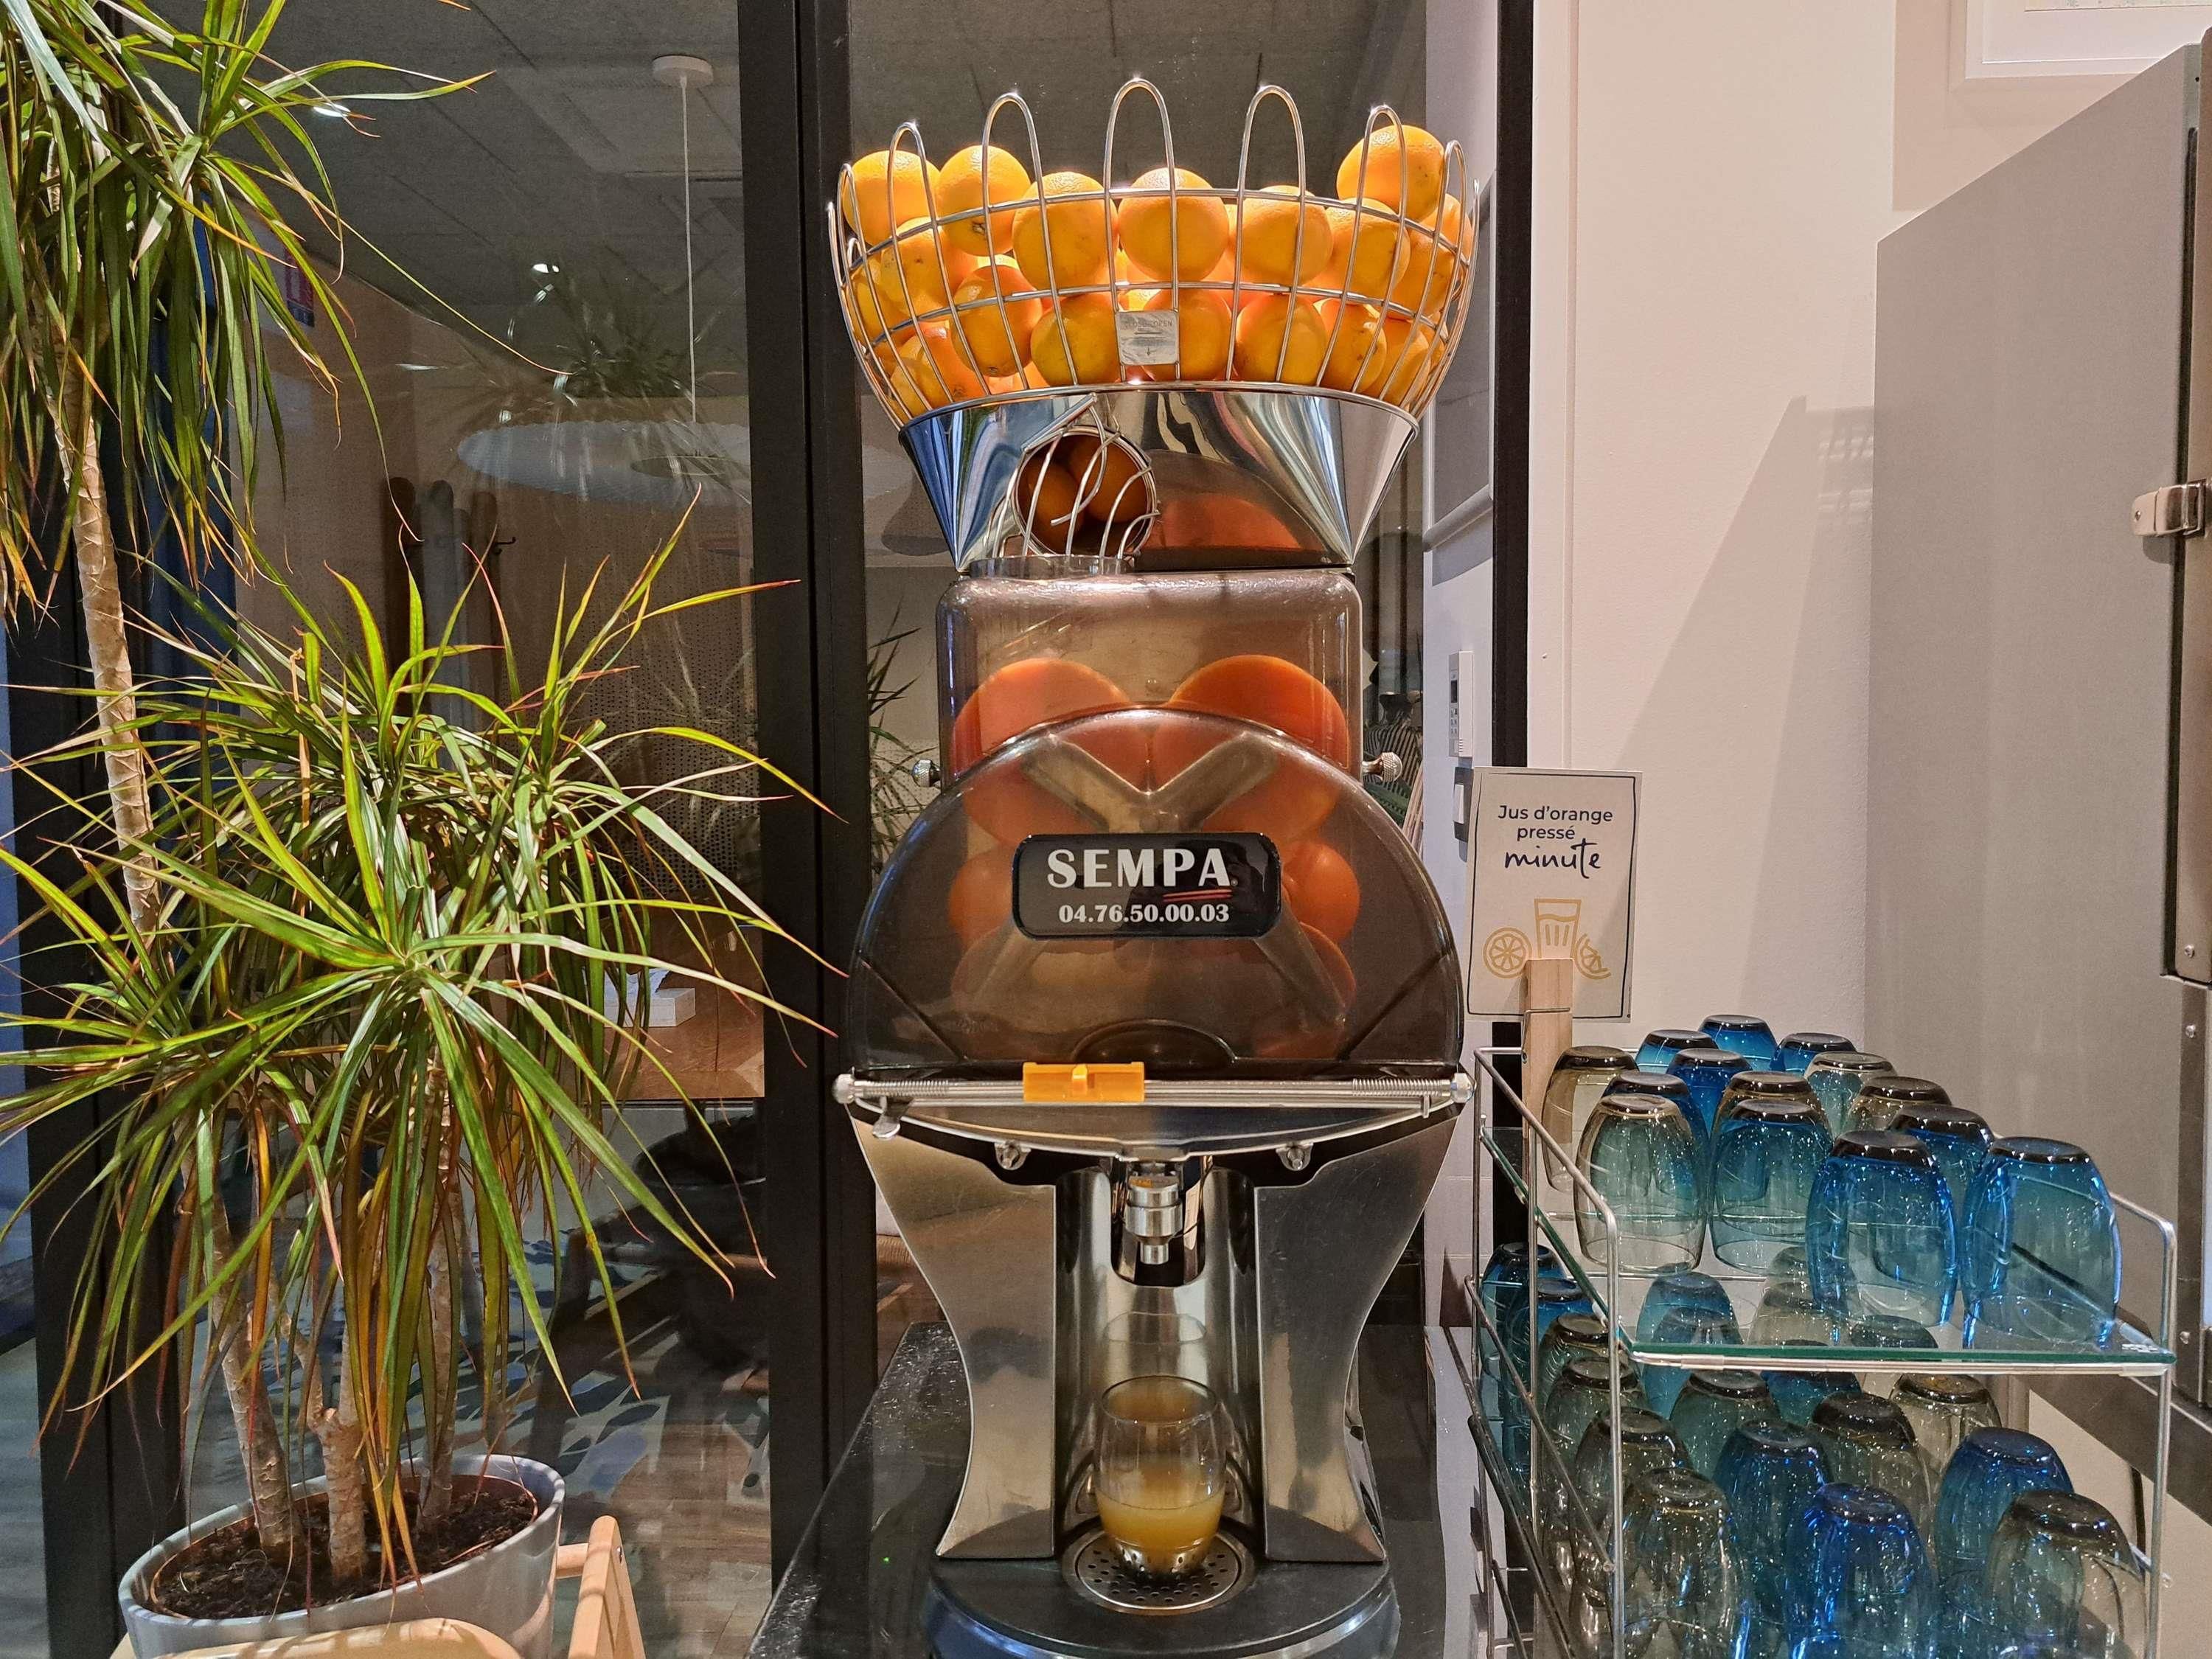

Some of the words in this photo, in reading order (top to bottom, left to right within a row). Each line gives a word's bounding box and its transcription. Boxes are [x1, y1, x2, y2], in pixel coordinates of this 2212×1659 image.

[1498, 804, 1528, 820] Jus
[1534, 805, 1613, 825] d'orange
[1517, 825, 1576, 841] pressé
[1047, 848, 1231, 888] SEMPA
[1504, 838, 1601, 879] minute
[1059, 903, 1229, 922] 04.76.50.00.03
